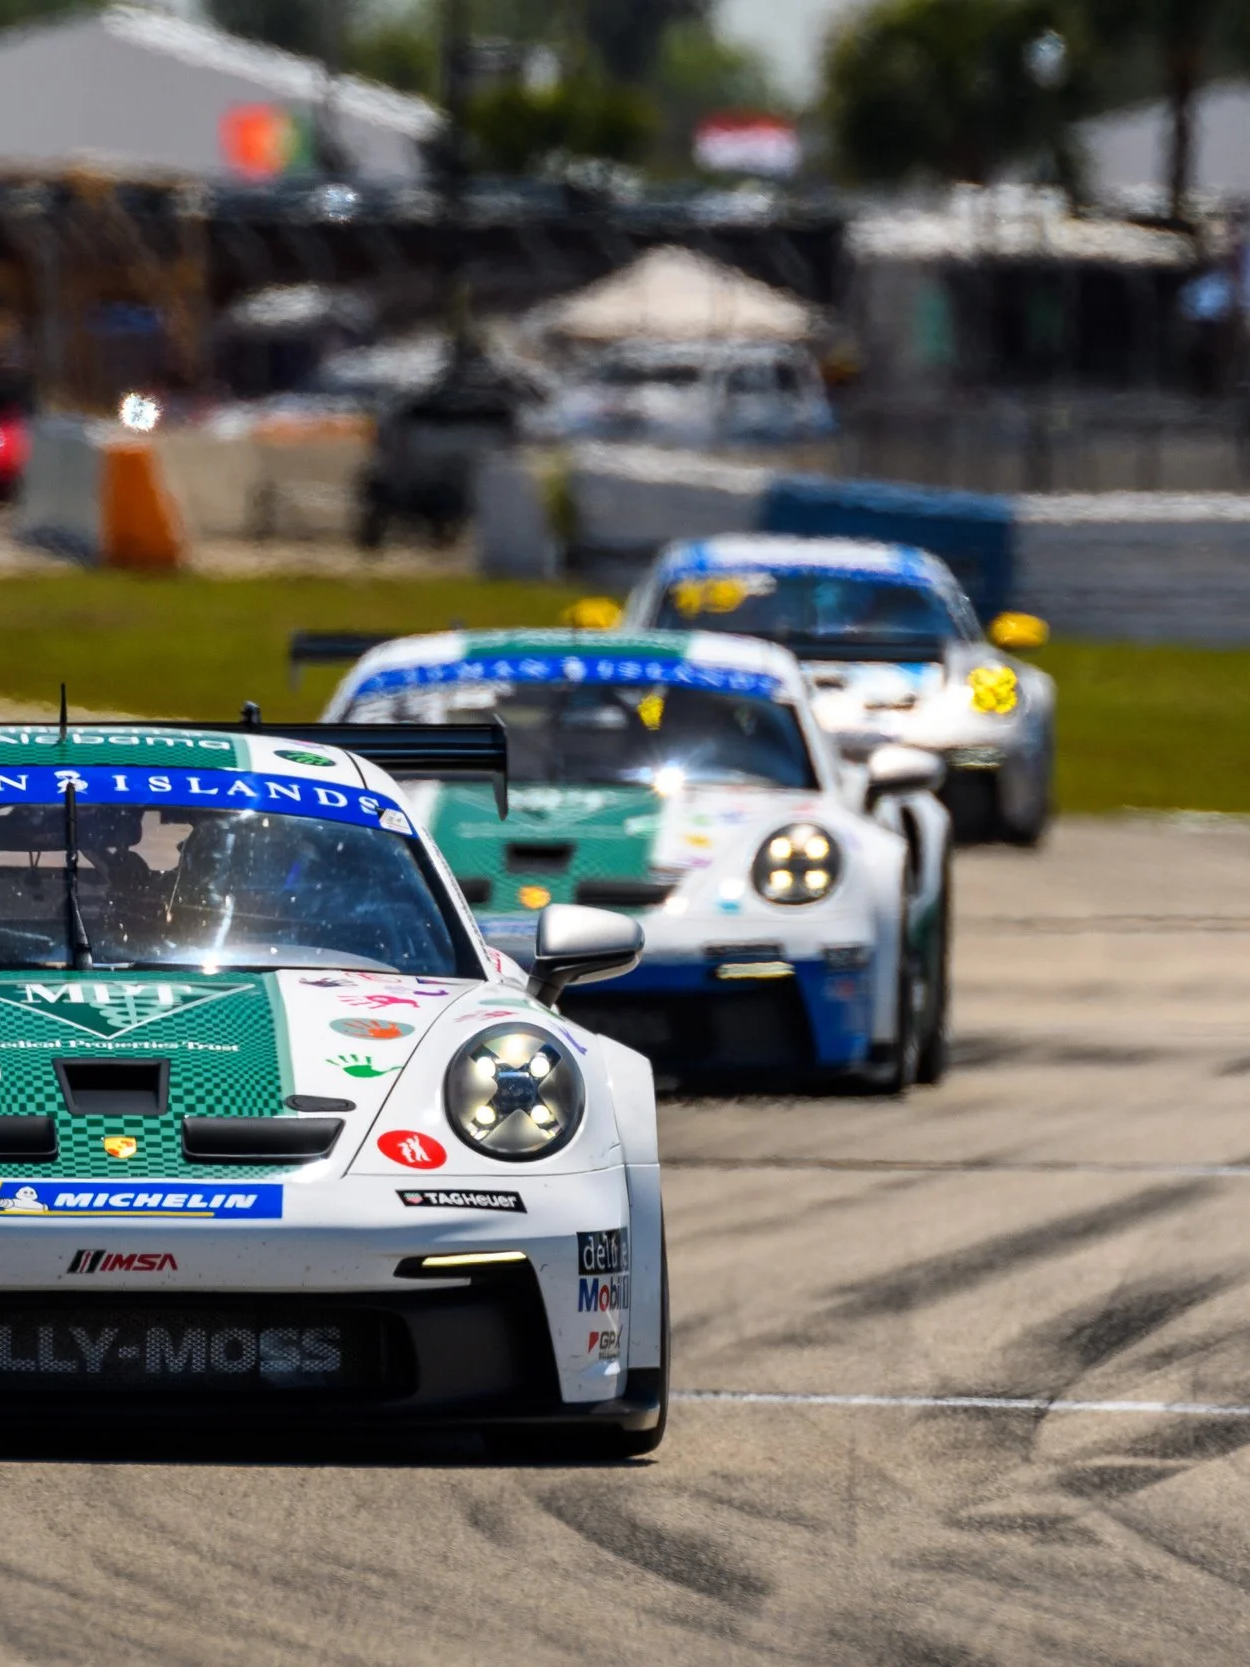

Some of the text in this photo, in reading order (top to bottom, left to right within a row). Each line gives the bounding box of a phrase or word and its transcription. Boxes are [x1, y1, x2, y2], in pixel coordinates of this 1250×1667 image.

[112, 774, 380, 815] ISLANDS
[69, 1040, 179, 1050] Properties
[182, 1041, 238, 1051] Trust
[54, 1192, 258, 1210] MICHELIN
[425, 1192, 517, 1207] TAGHeuer
[100, 1253, 179, 1272] IMSA
